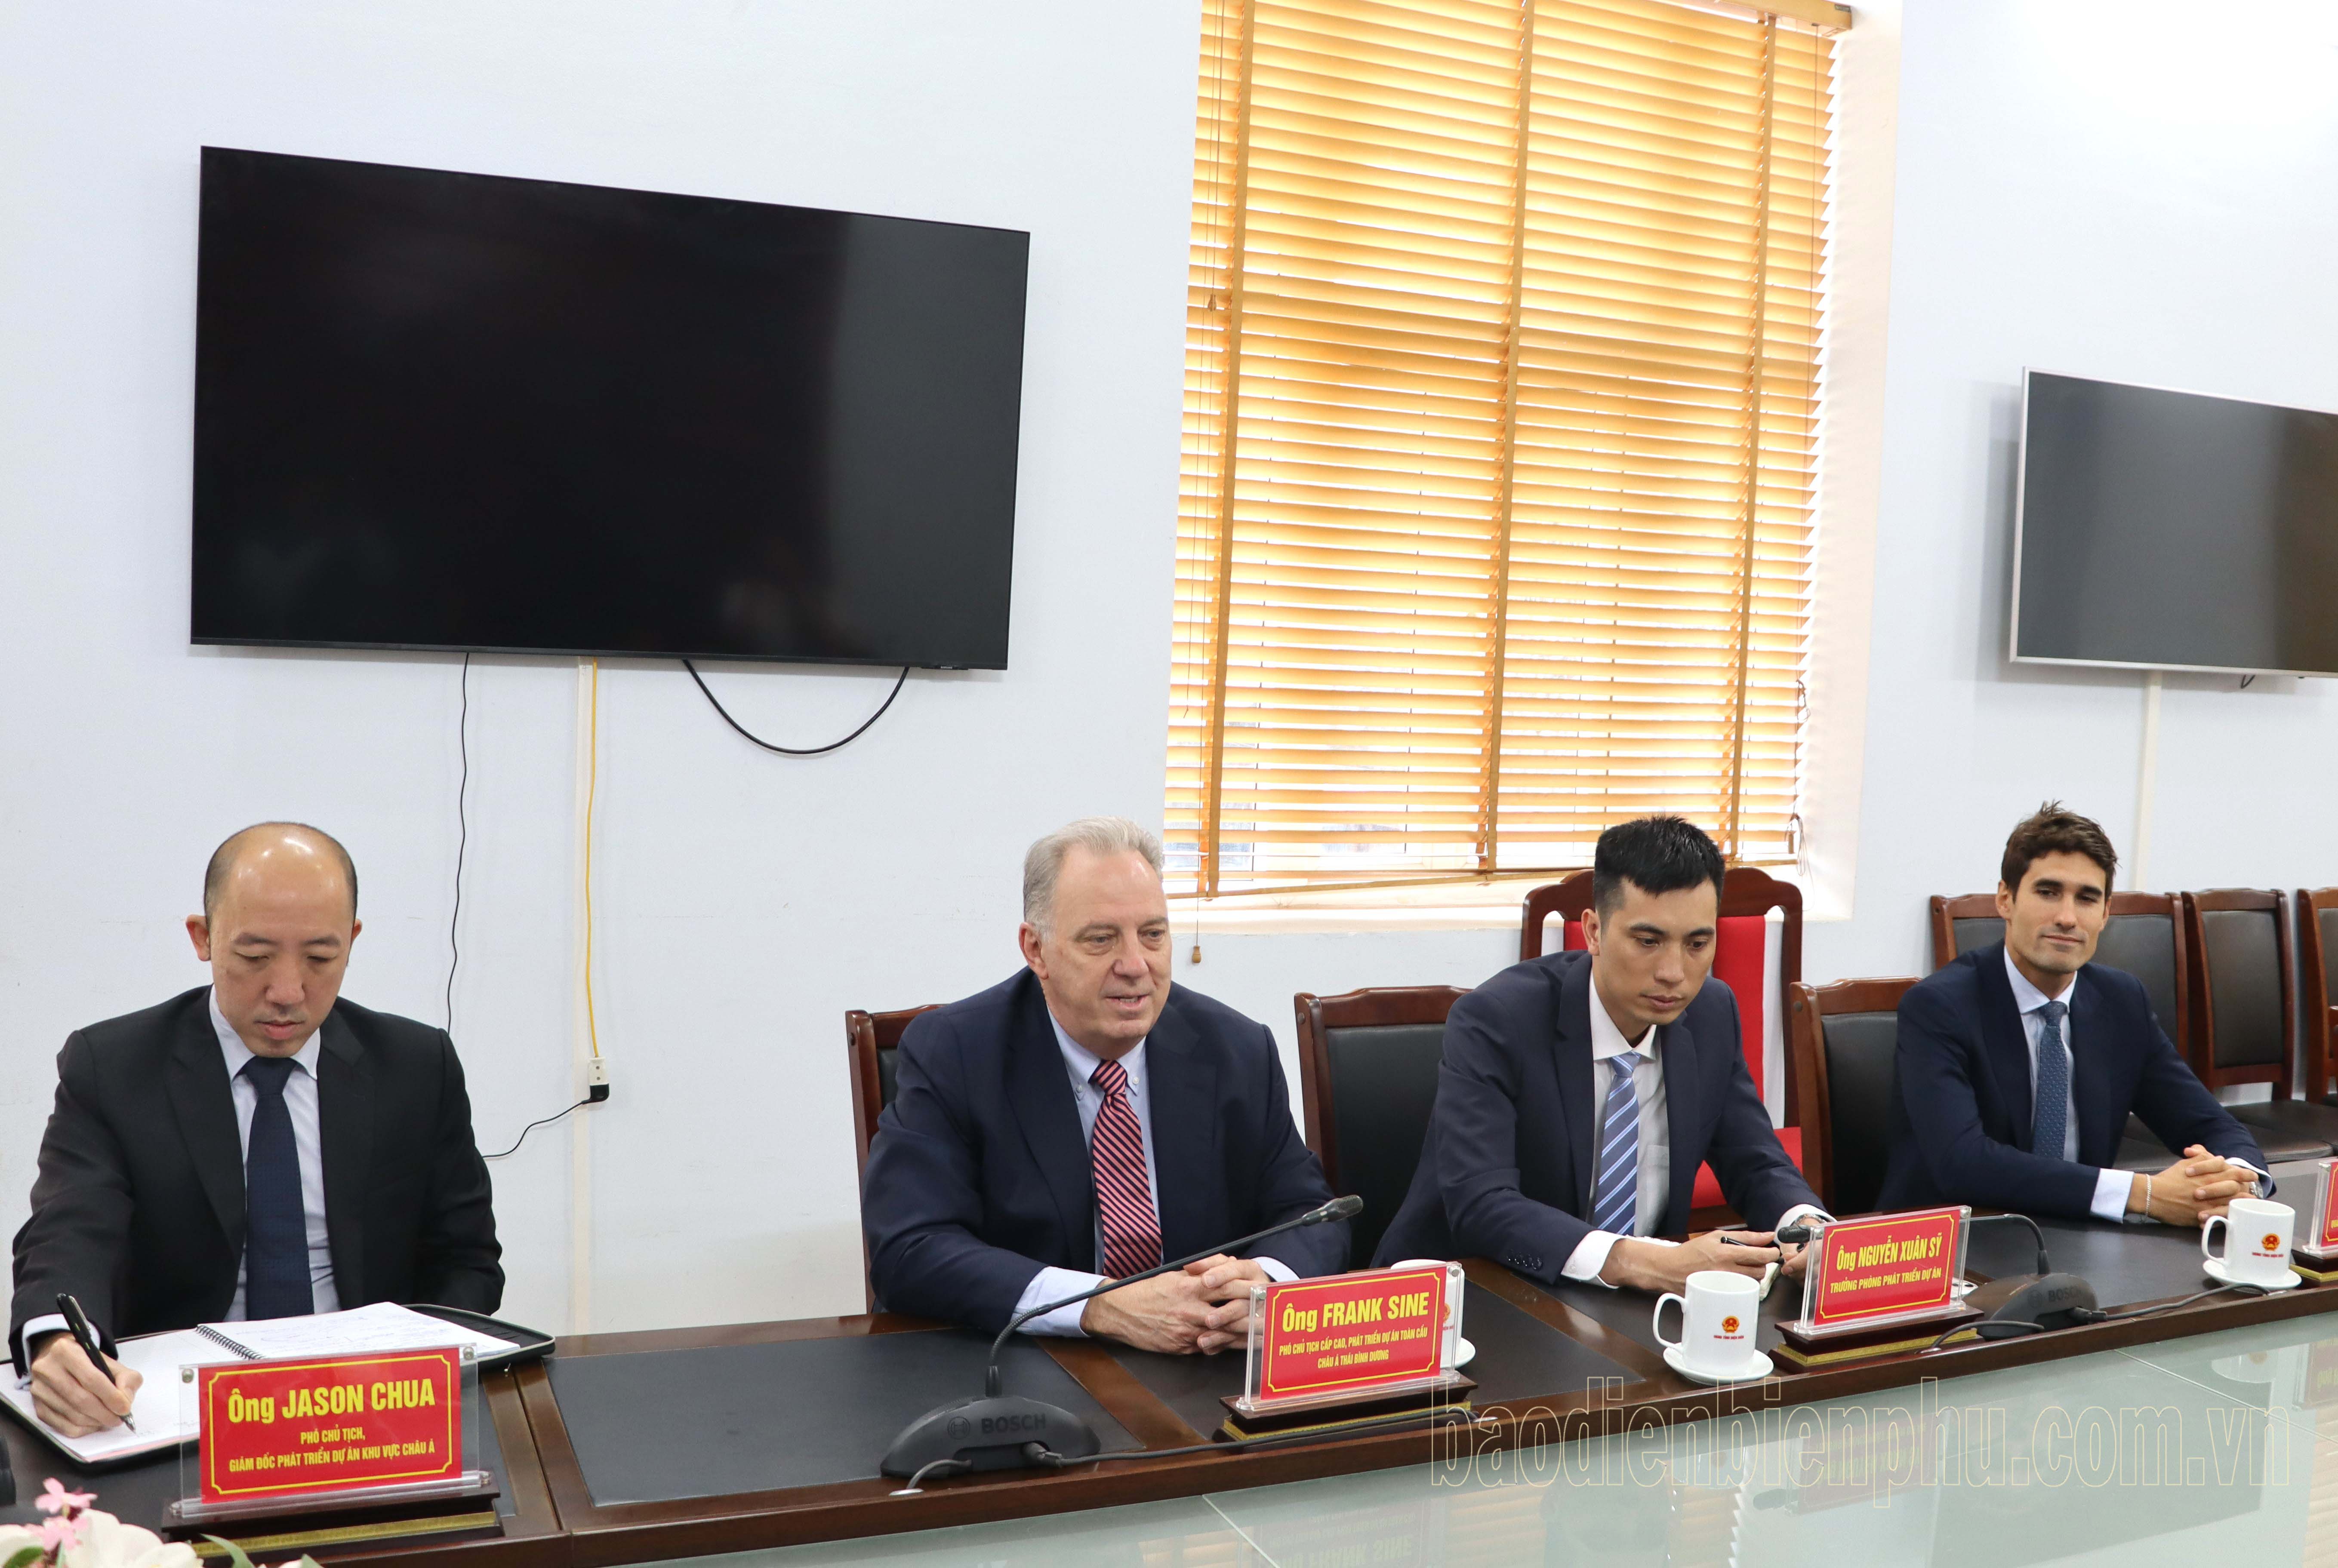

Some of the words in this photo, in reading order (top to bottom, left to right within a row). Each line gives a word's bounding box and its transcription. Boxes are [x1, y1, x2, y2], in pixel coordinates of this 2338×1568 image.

[1836, 1245, 1857, 1271] Ông
[1857, 1235, 1899, 1267] NGUYỄN
[1900, 1235, 1928, 1261] XUÂN
[1928, 1232, 1942, 1257] SỸ
[1830, 1277, 1857, 1294] TRƯỞNG
[1858, 1275, 1882, 1289] PHÒNG
[1883, 1272, 1900, 1285] PHÁT
[1902, 1267, 1921, 1283] TRIỂN
[1922, 1268, 1932, 1282] DỰ
[1932, 1266, 1941, 1278] ÁN
[1282, 1303, 1317, 1332] Ông
[1322, 1297, 1383, 1327] FRANK
[1388, 1292, 1430, 1320] SINE
[1279, 1342, 1291, 1356] PHÓ
[1293, 1338, 1305, 1354] CHỦ
[1306, 1340, 1319, 1354] TỊCH
[1320, 1336, 1333, 1351] CẤP
[1334, 1337, 1347, 1349] CAO,
[1348, 1334, 1363, 1347] PHÁT
[1364, 1329, 1381, 1345] TRIỂN
[1382, 1331, 1391, 1344] DỰ
[1391, 1329, 1399, 1341] ÁN
[1400, 1327, 1415, 1340] TOÀN
[1318, 1355, 1334, 1368] CHÂU
[1335, 1353, 1339, 1366] Á
[1340, 1352, 1353, 1365] THÁI
[1354, 1351, 1368, 1363] BÌNH
[1369, 1349, 1389, 1362] DƯƠNG
[228, 1388, 275, 1423] Ông
[282, 1384, 363, 1418] JASON
[371, 1378, 435, 1410] CHUA
[301, 1428, 319, 1445] PHÓ
[322, 1424, 340, 1442] CHỦ
[342, 1427, 365, 1443] TỊCH,
[981, 1414, 1046, 1434] BOSCH
[229, 1456, 254, 1472] GIÁM
[256, 1452, 275, 1470] ĐỐC
[277, 1451, 301, 1467] PHÁT
[303, 1446, 330, 1465] TRIỂN
[332, 1448, 345, 1465] DỰ
[347, 1446, 360, 1461] ÁN
[362, 1446, 380, 1460] KHU
[382, 1443, 400, 1460] VỰC
[402, 1440, 426, 1455] CHÂU
[428, 1439, 435, 1453] Á
